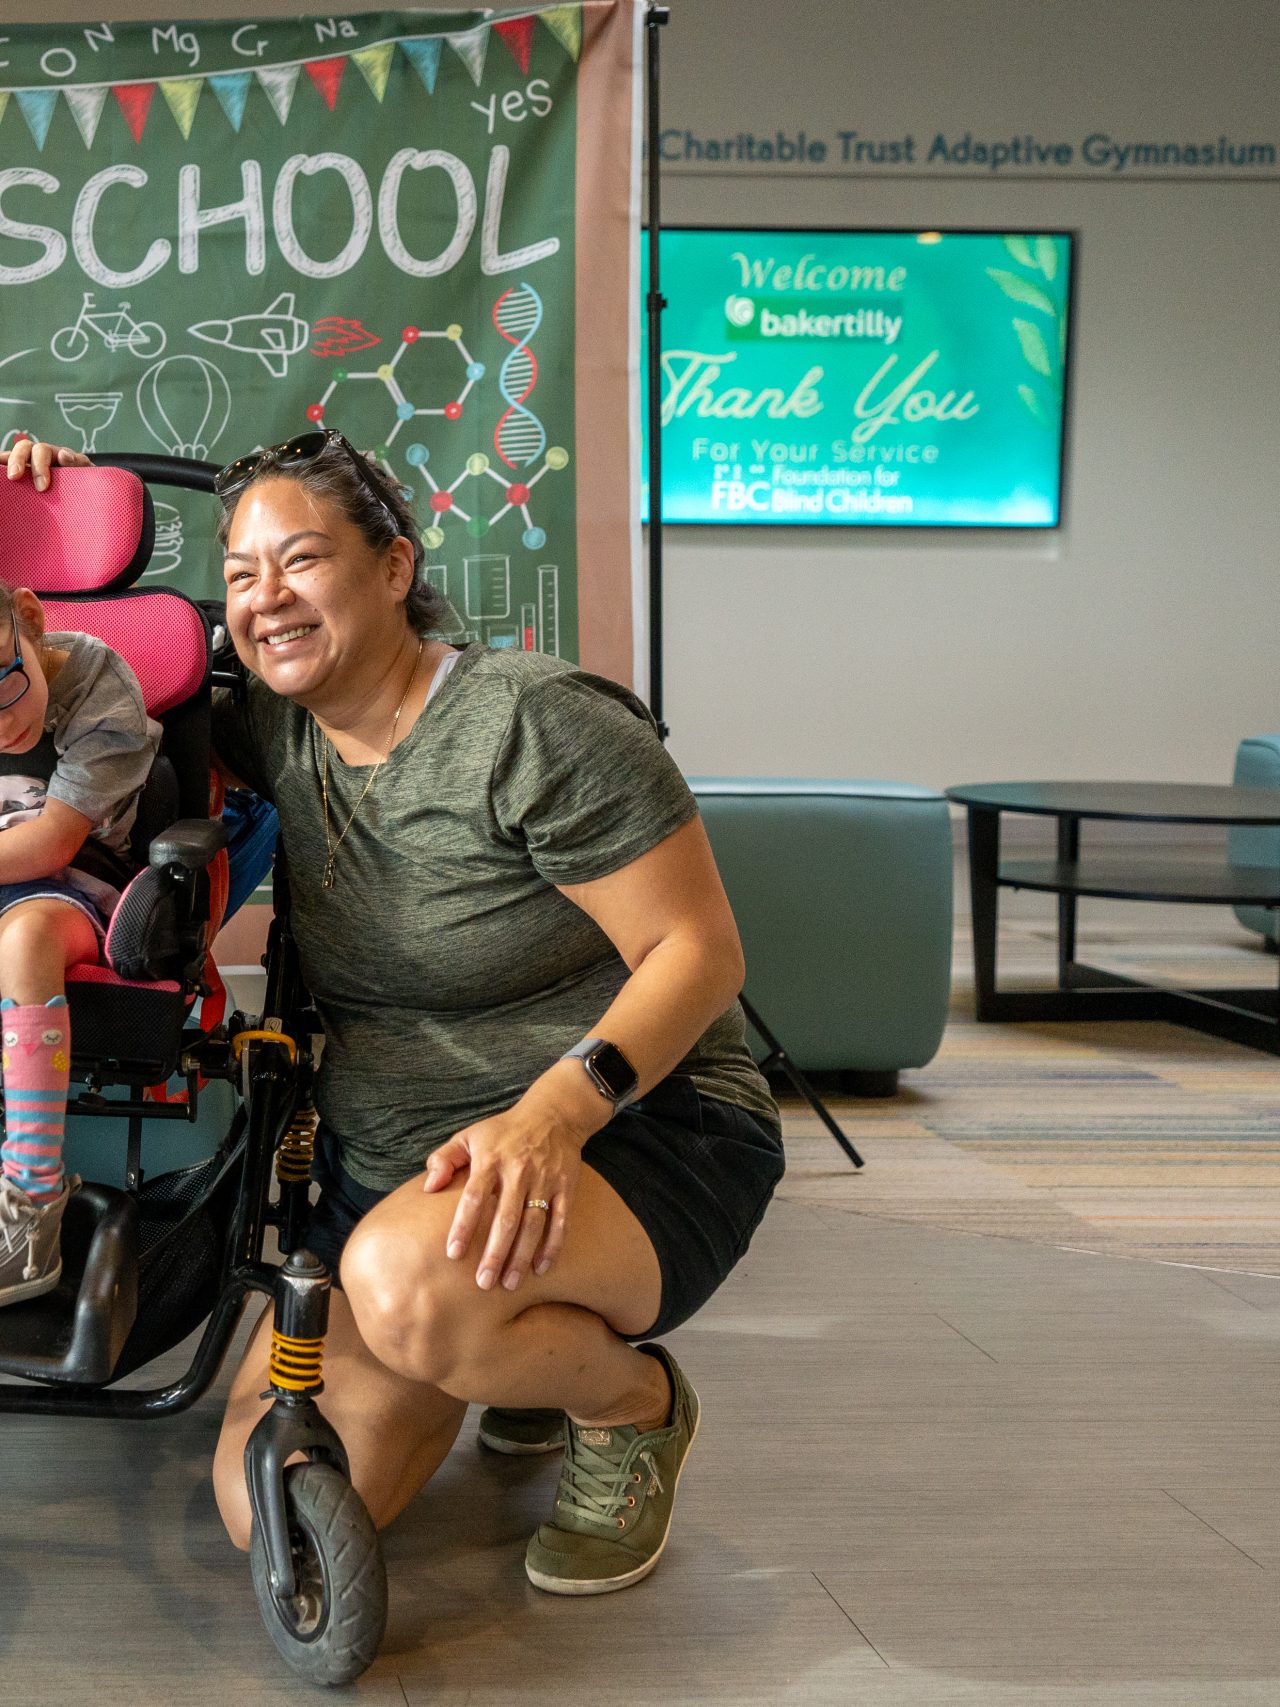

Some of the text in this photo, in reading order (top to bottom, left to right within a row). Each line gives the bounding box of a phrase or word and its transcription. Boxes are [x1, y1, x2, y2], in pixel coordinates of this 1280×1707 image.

[39, 47, 77, 77] O
[84, 22, 115, 53] N
[152, 26, 200, 66] Mg
[230, 25, 269, 57] Cr
[315, 18, 358, 41] Na
[472, 79, 553, 133] yes
[660, 128, 827, 162] Charitable
[837, 132, 915, 165] Trust
[928, 133, 1073, 171] Adaptive
[1082, 133, 1277, 171] Gymnasium
[731, 252, 907, 291] Welcome
[761, 309, 903, 345] bakertilly
[661, 349, 979, 444] Thank You
[692, 438, 939, 464] For Your Service
[711, 480, 771, 512] FBC
